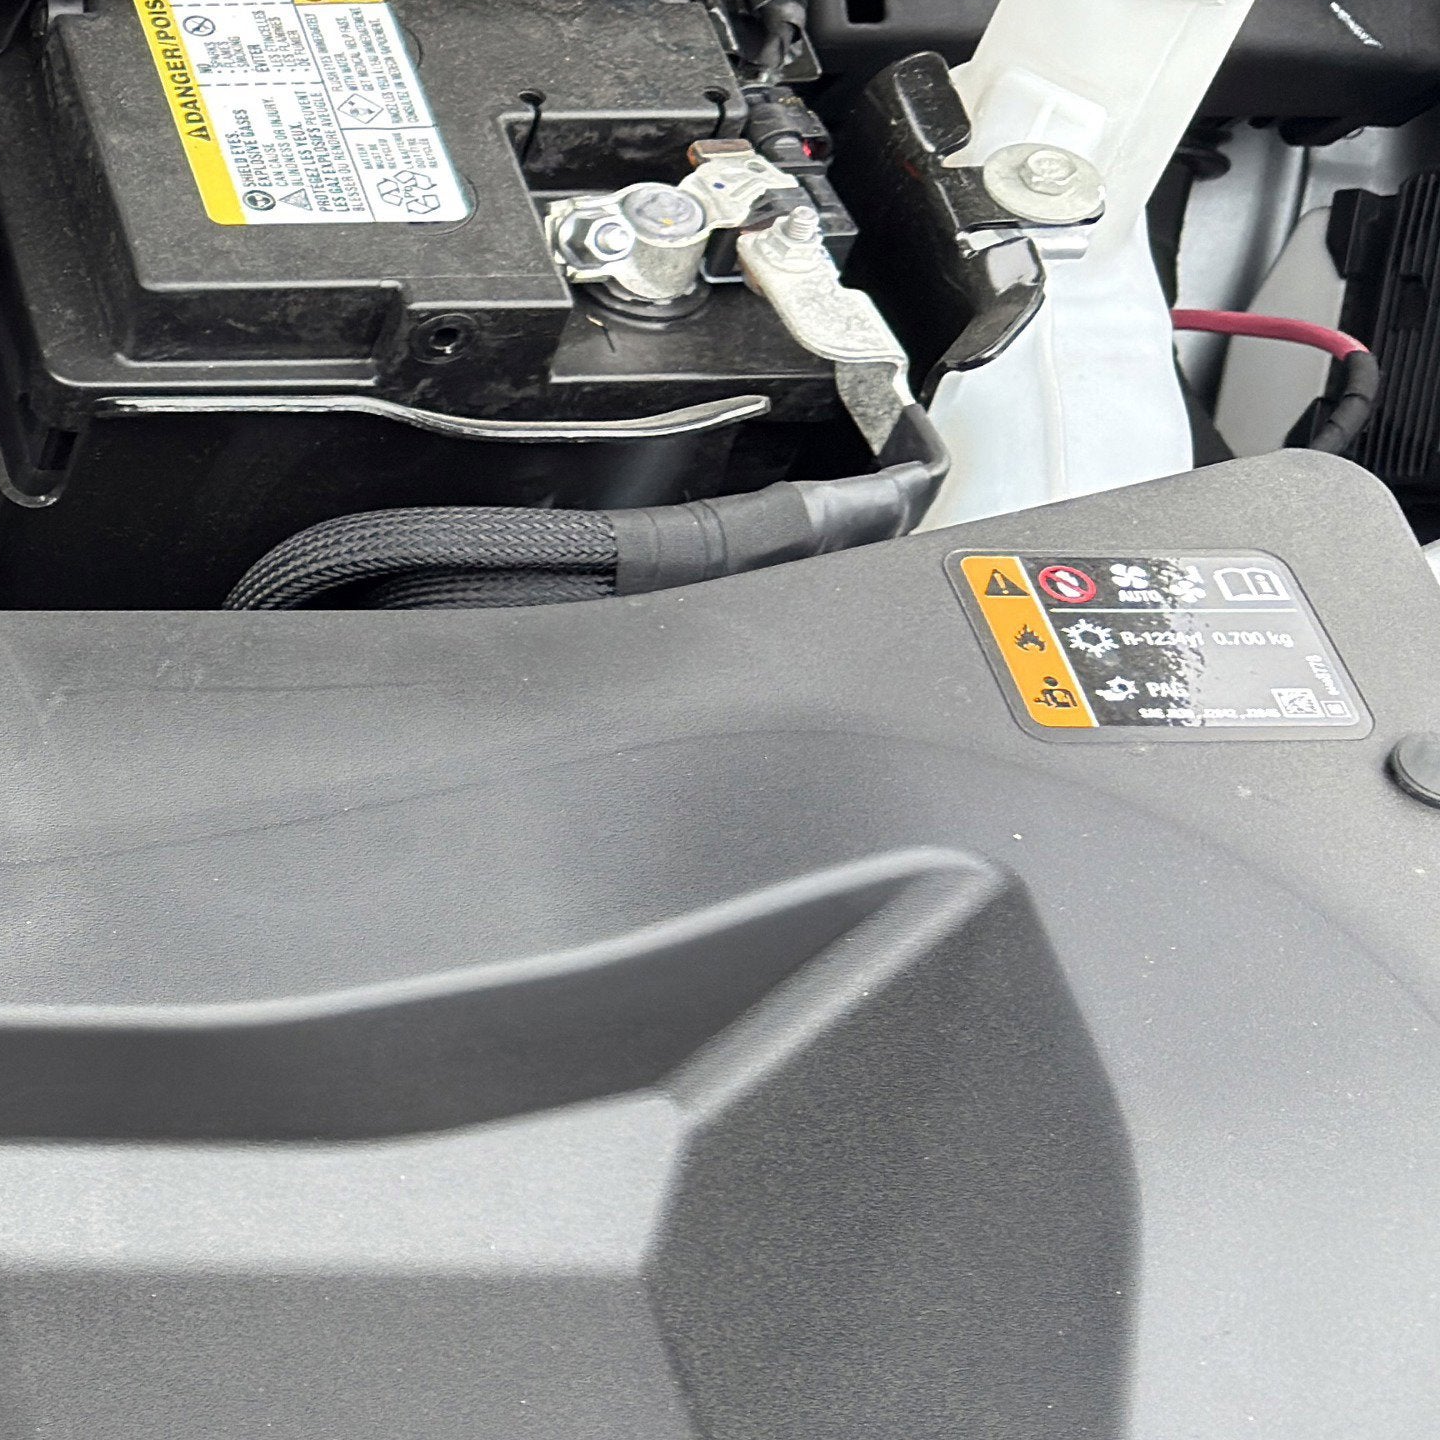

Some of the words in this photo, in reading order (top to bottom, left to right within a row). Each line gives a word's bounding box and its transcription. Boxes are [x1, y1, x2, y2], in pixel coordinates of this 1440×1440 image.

[268, 16, 289, 51] FLAMMES
[286, 29, 304, 55] FUMER
[341, 33, 357, 49] HELP
[203, 41, 222, 68] SPARKS
[216, 40, 235, 68] FLAMES
[227, 36, 249, 67] SMOKING
[268, 53, 283, 67] LES
[281, 53, 297, 67] LES
[296, 57, 310, 66] DE
[350, 51, 368, 77] MEDICAL
[196, 63, 212, 73] NO
[359, 79, 374, 91] GET
[294, 90, 316, 125] PEUVENT
[310, 92, 332, 127] AVEUGLE
[232, 109, 254, 137] GASES
[272, 128, 287, 140] OR
[224, 130, 245, 155] EYES.
[306, 127, 335, 174] EXPLOSIFS
[324, 129, 344, 160] RENDRE
[243, 140, 272, 187] EXPLOSIVE
[261, 143, 281, 168] CAUSE
[277, 142, 303, 186] BLINDNESS
[297, 149, 315, 165] LES
[337, 162, 350, 173] OU
[234, 157, 256, 187] SHIELD
[272, 170, 288, 186] CAN
[324, 176, 343, 194] GAZ
[341, 175, 364, 211] BLESSER
[331, 196, 350, 212] LES
[1119, 589, 1162, 603] AUTO
[1120, 631, 1204, 648] R-1234yf
[1213, 631, 1262, 646] 0.700
[1267, 631, 1293, 649] kg
[1147, 680, 1189, 698] PAG
